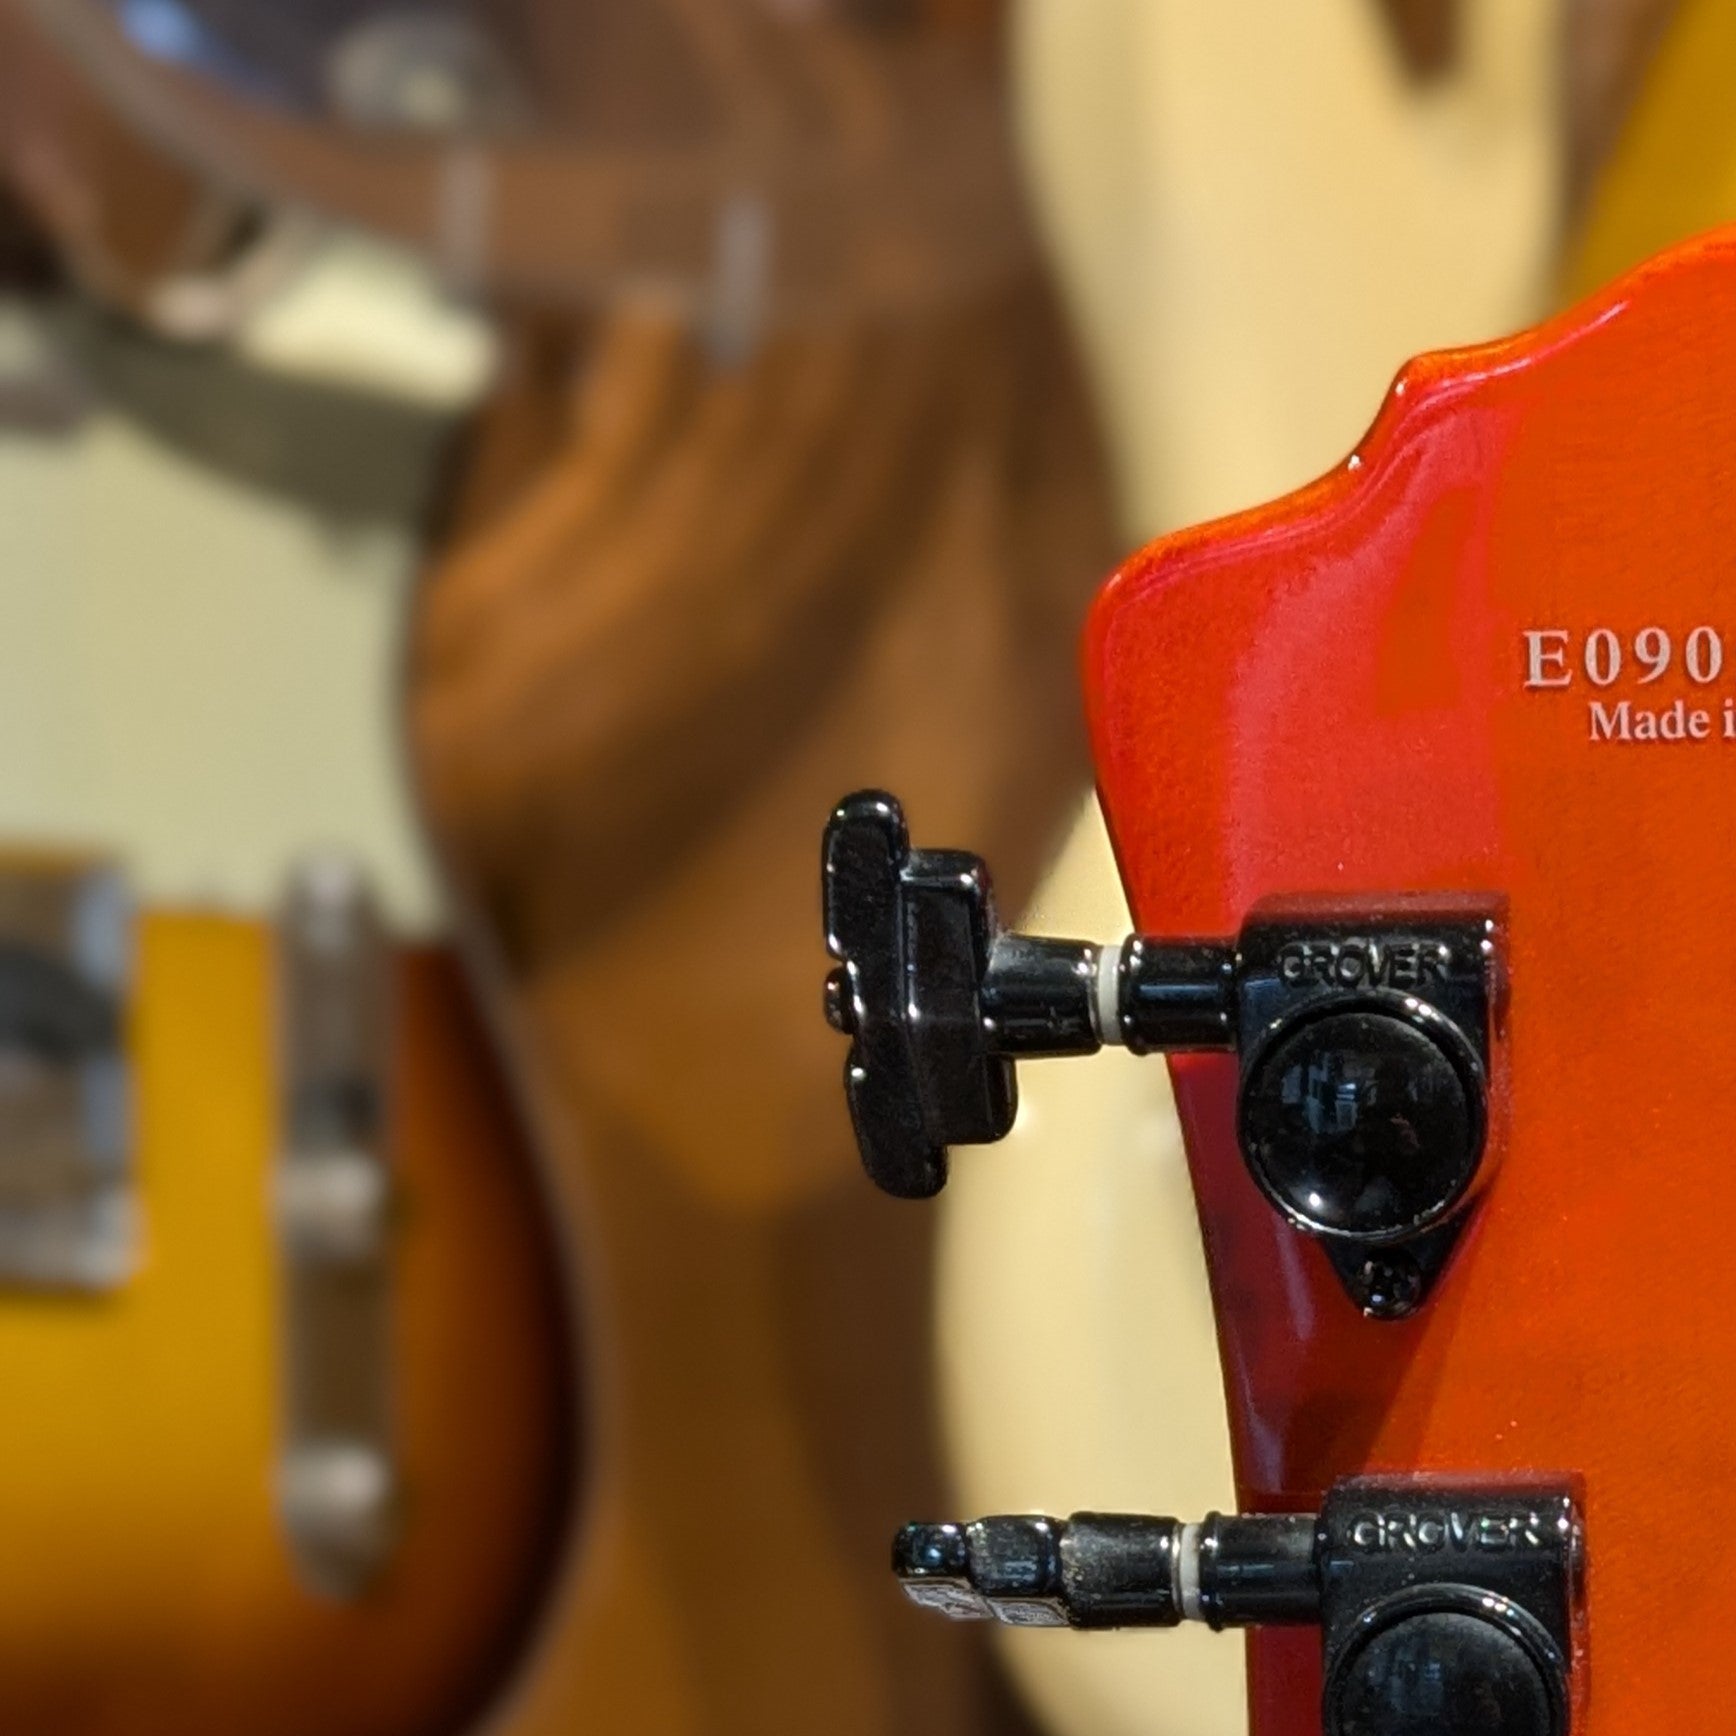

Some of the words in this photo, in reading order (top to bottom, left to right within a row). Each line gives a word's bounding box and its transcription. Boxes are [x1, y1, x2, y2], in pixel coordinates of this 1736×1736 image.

[1589, 700, 1711, 741] Made
[1278, 940, 1451, 988] GROVER
[1348, 1509, 1543, 1550] GROVER
